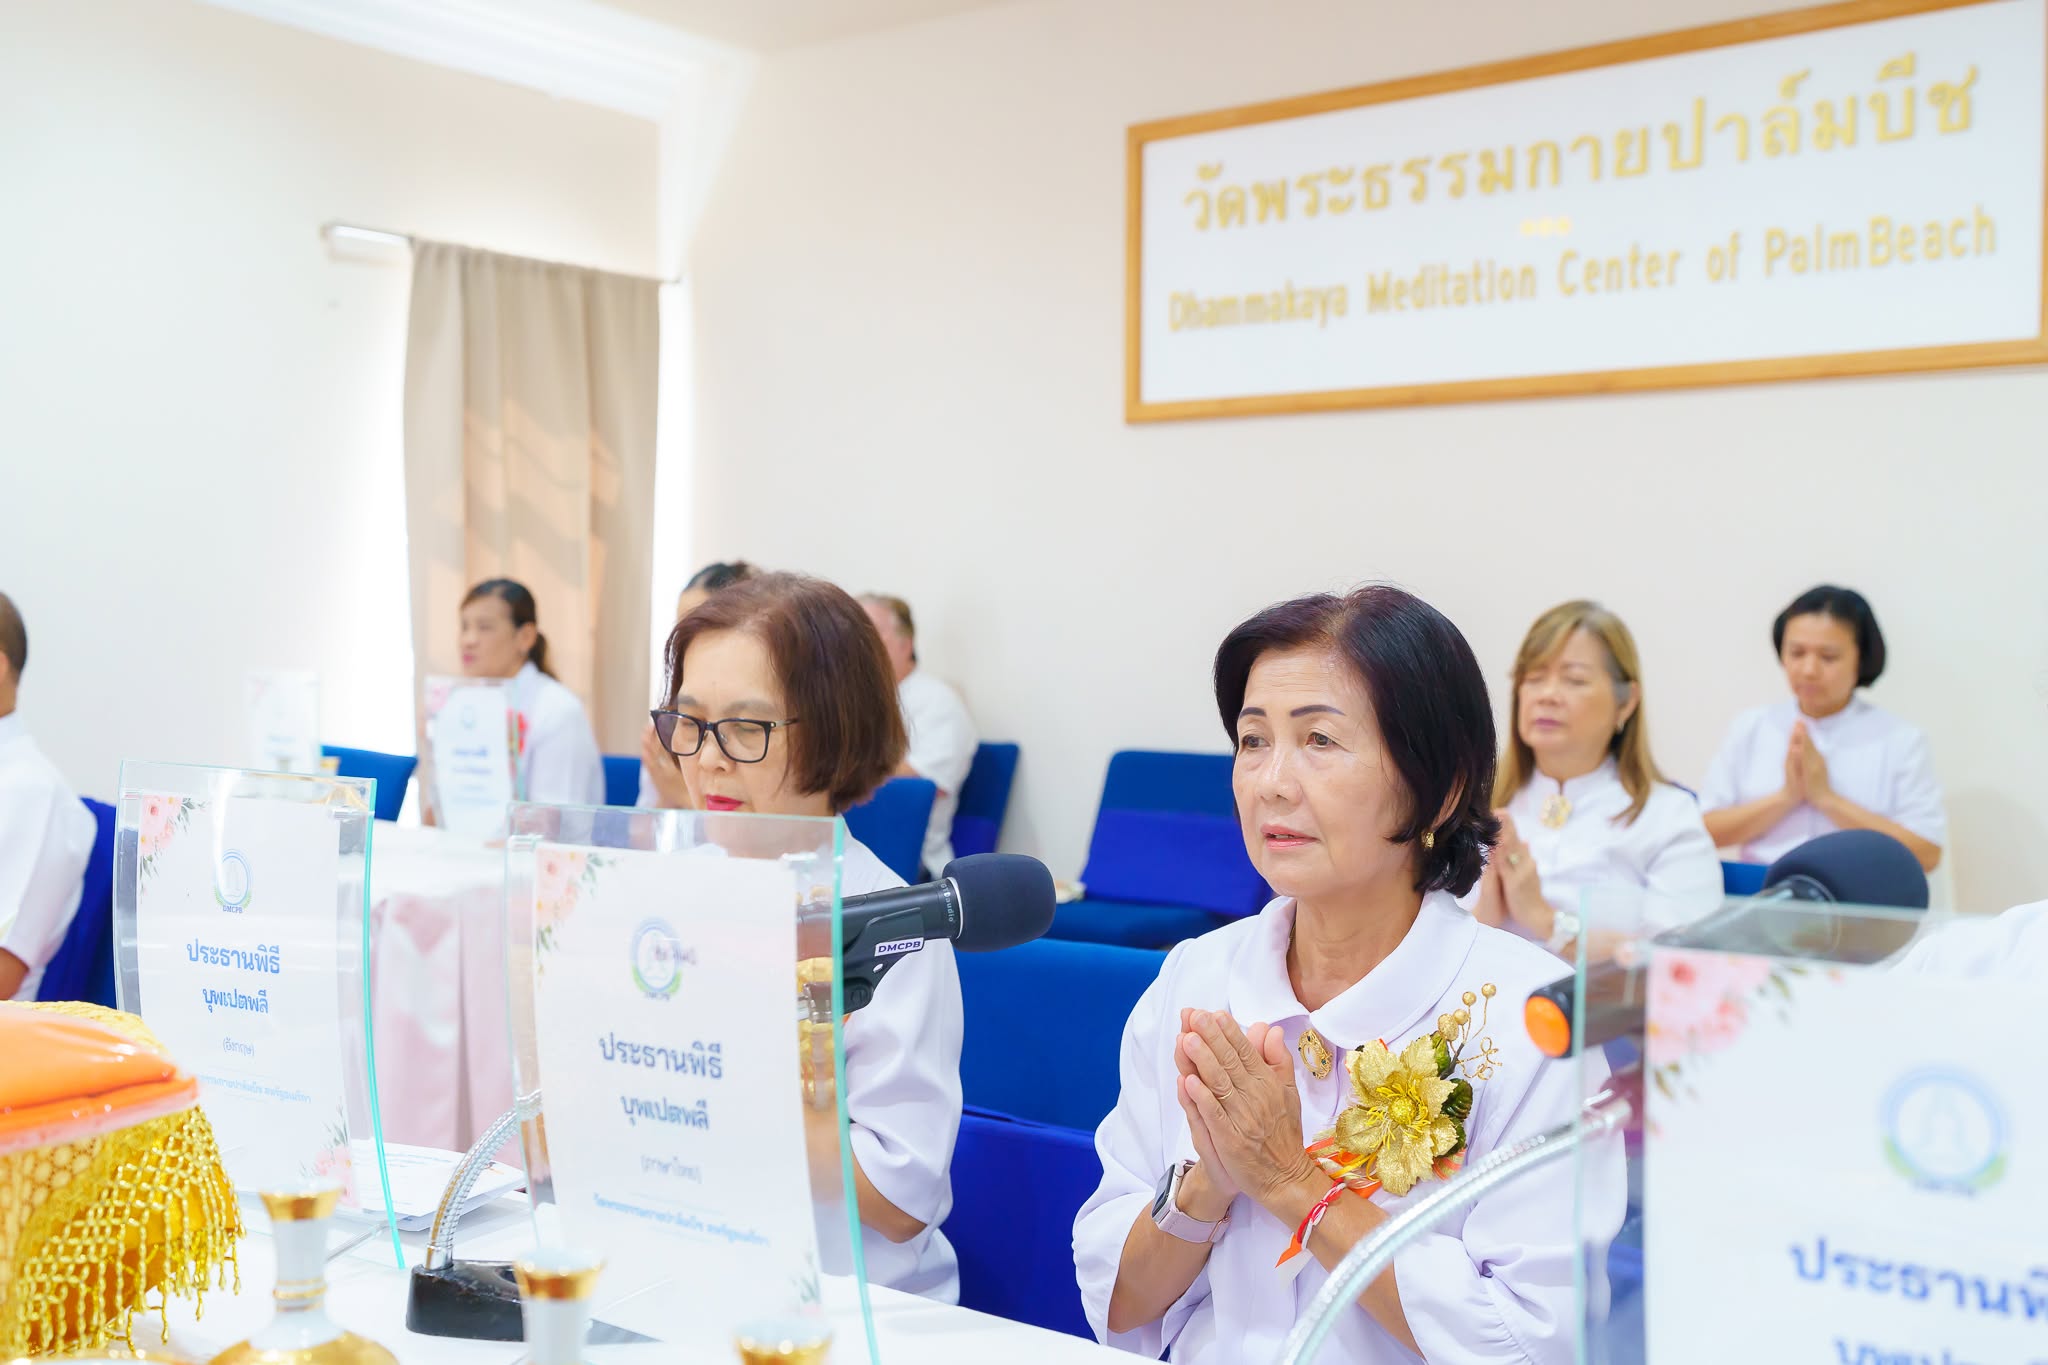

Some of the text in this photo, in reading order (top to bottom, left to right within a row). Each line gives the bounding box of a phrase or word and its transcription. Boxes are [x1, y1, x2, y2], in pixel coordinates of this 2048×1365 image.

[1184, 52, 1979, 231] วัดพระธรรมกายปาล์มบีช
[1168, 278, 1347, 332] Dhammakaya
[1366, 259, 1536, 315] Meditation
[1558, 243, 1681, 297] Center
[1706, 231, 1741, 283] of
[186, 938, 281, 974] ประธานพิธี
[878, 941, 921, 953] DMCPB
[202, 987, 269, 1014] บุพเปตพลี
[599, 1032, 723, 1079] ประธานพิธี
